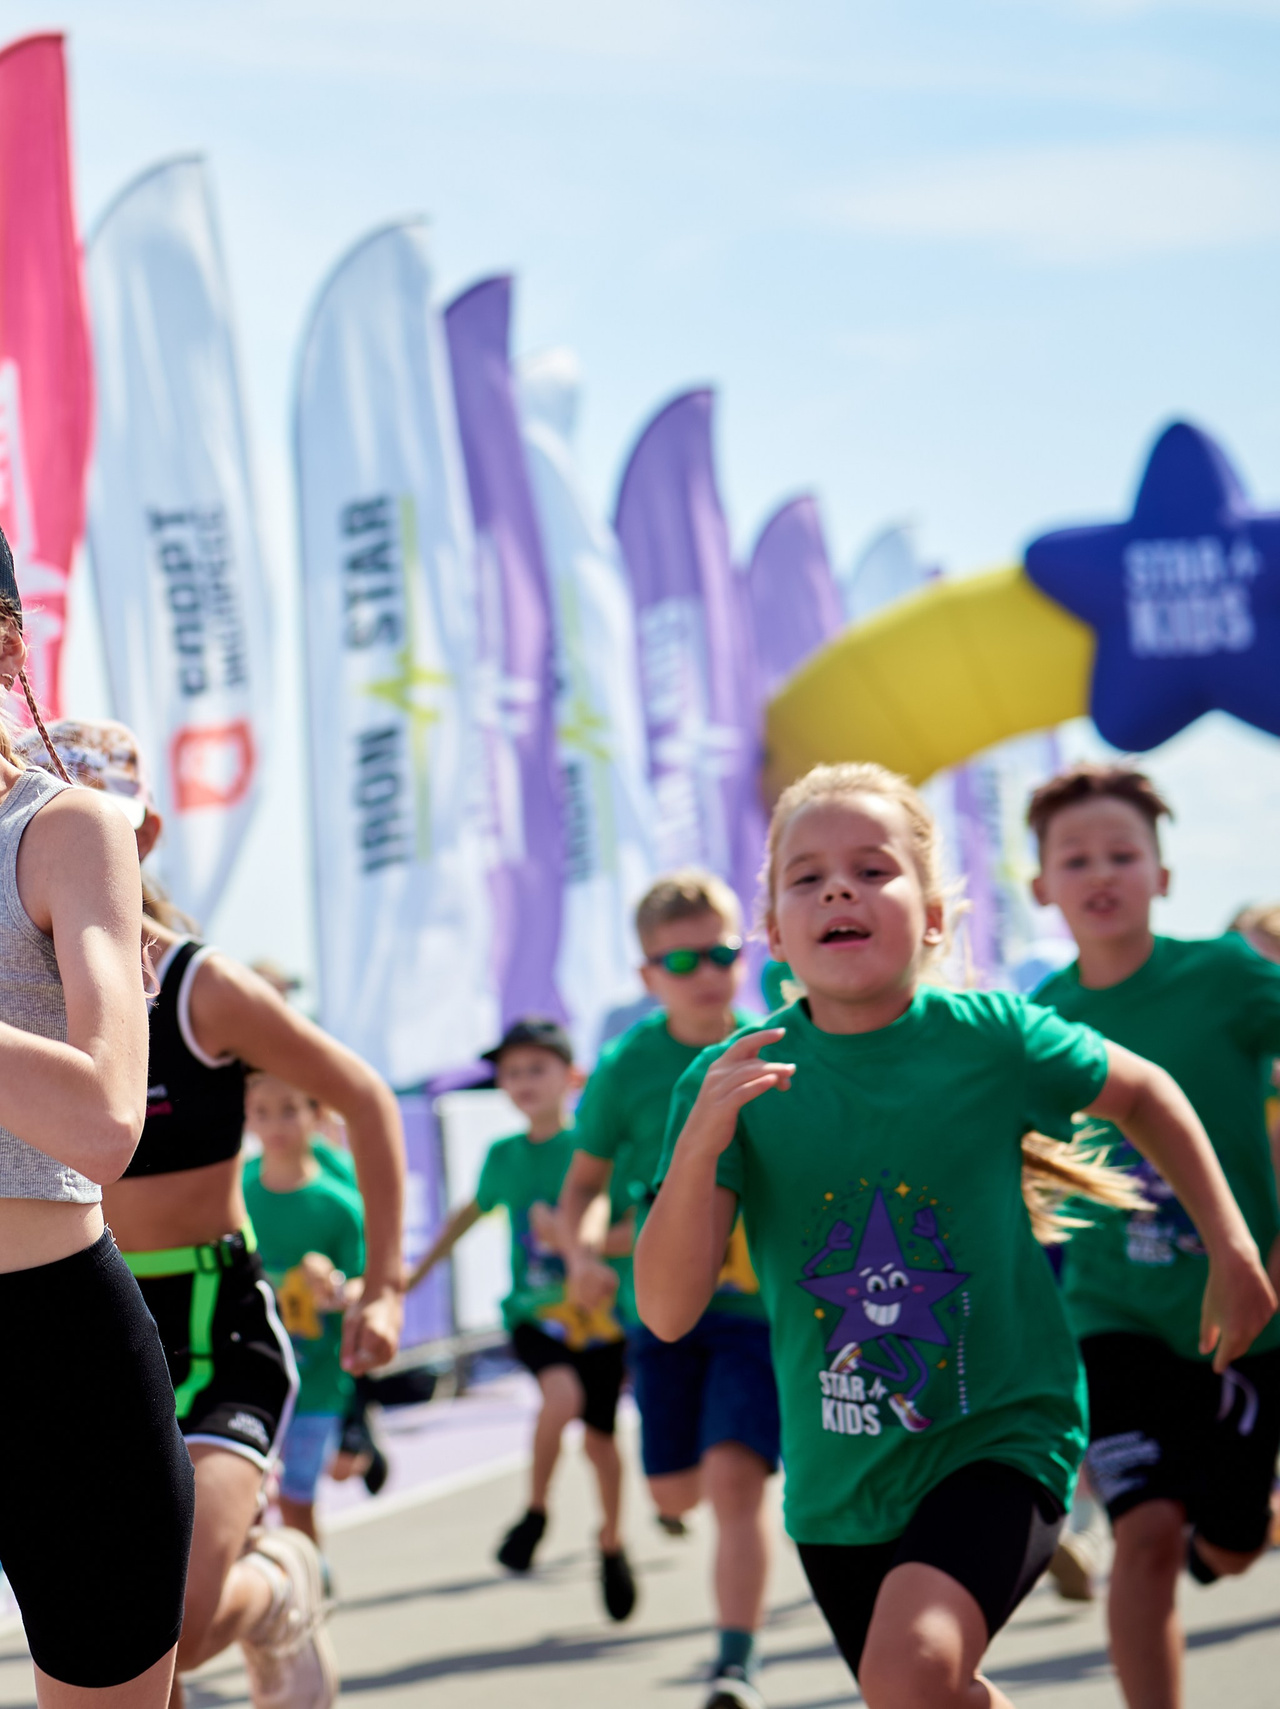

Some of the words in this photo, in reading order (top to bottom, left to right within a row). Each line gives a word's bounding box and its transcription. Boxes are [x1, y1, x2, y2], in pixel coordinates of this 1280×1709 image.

[339, 490, 401, 653] STAR
[354, 724, 411, 875] IRON
[818, 1369, 867, 1402] STAR
[821, 1397, 881, 1436] KIDS
